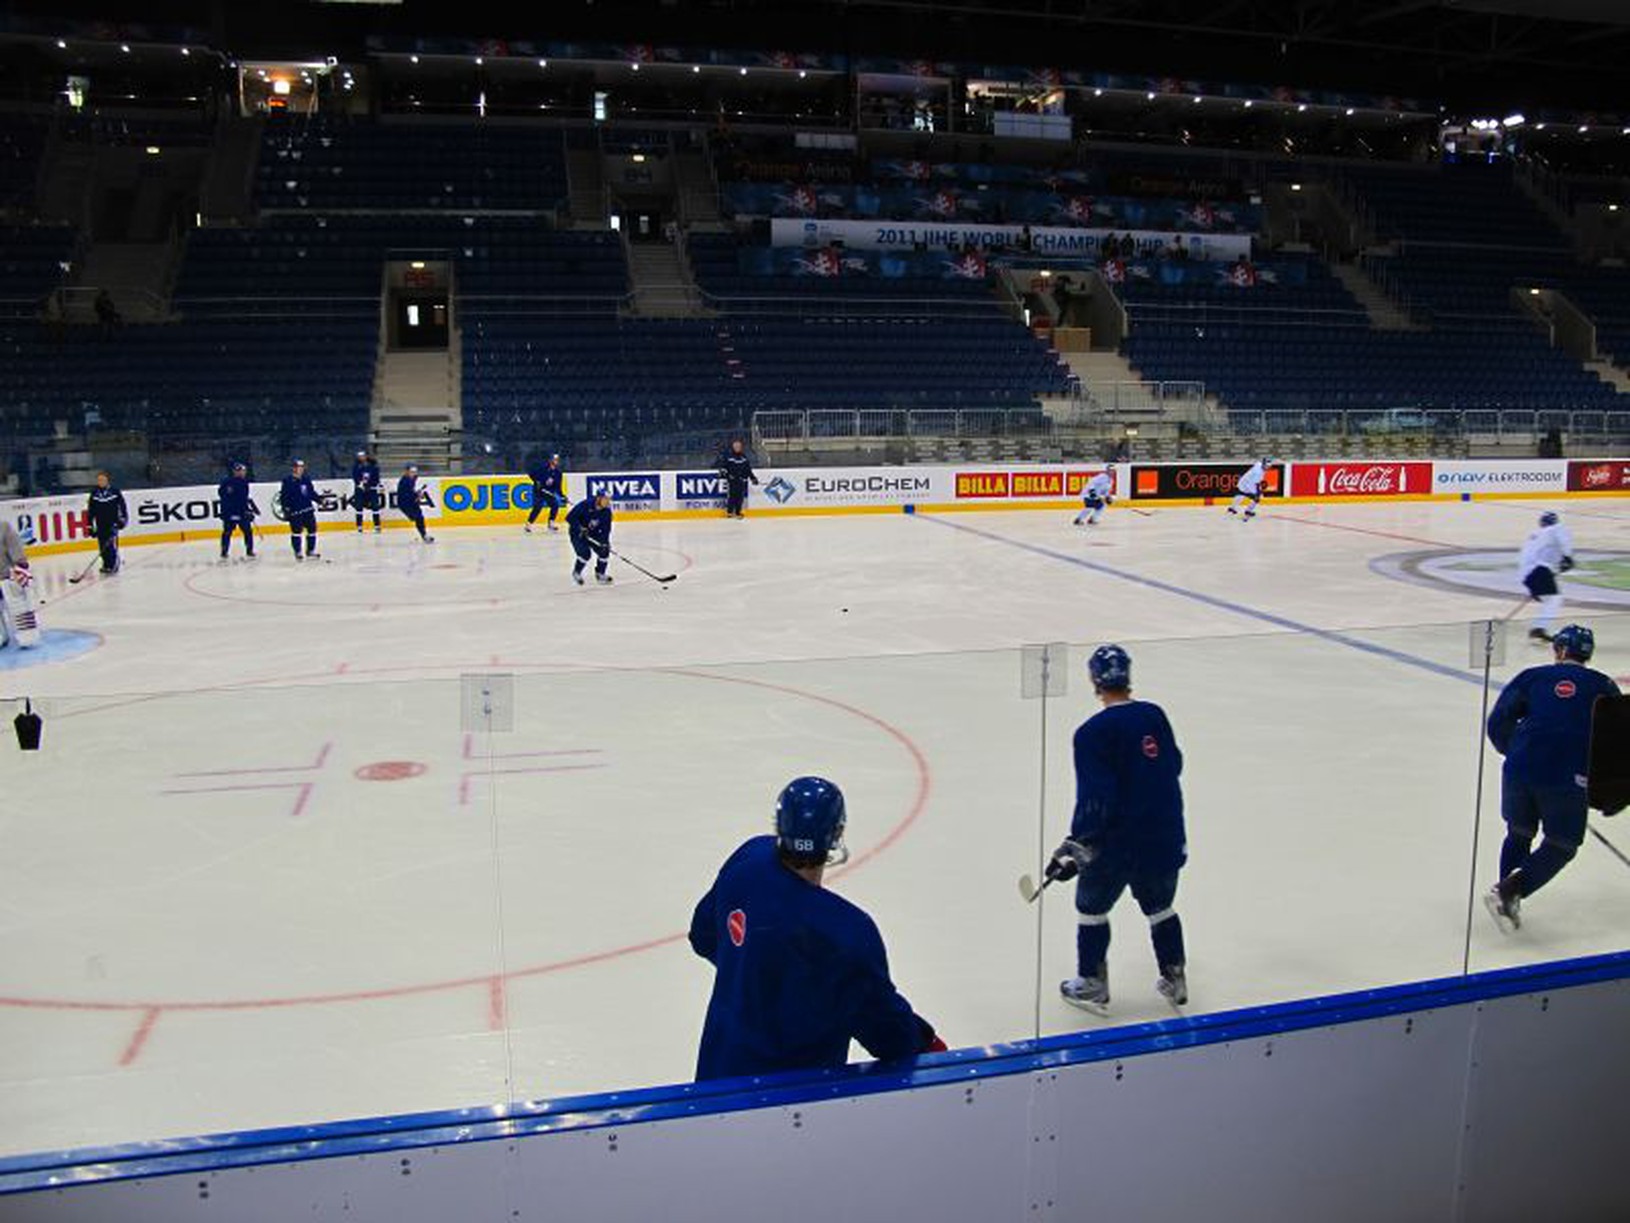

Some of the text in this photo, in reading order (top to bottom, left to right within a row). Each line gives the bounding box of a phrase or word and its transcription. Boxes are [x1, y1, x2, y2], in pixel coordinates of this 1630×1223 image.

[877, 229, 915, 244] 2011
[963, 231, 1024, 247] WORL
[681, 478, 730, 494] NIVE
[958, 476, 1006, 494] BILLA
[1013, 475, 1062, 493] BILLA
[38, 510, 92, 542] IIH
[794, 839, 814, 851] 68
